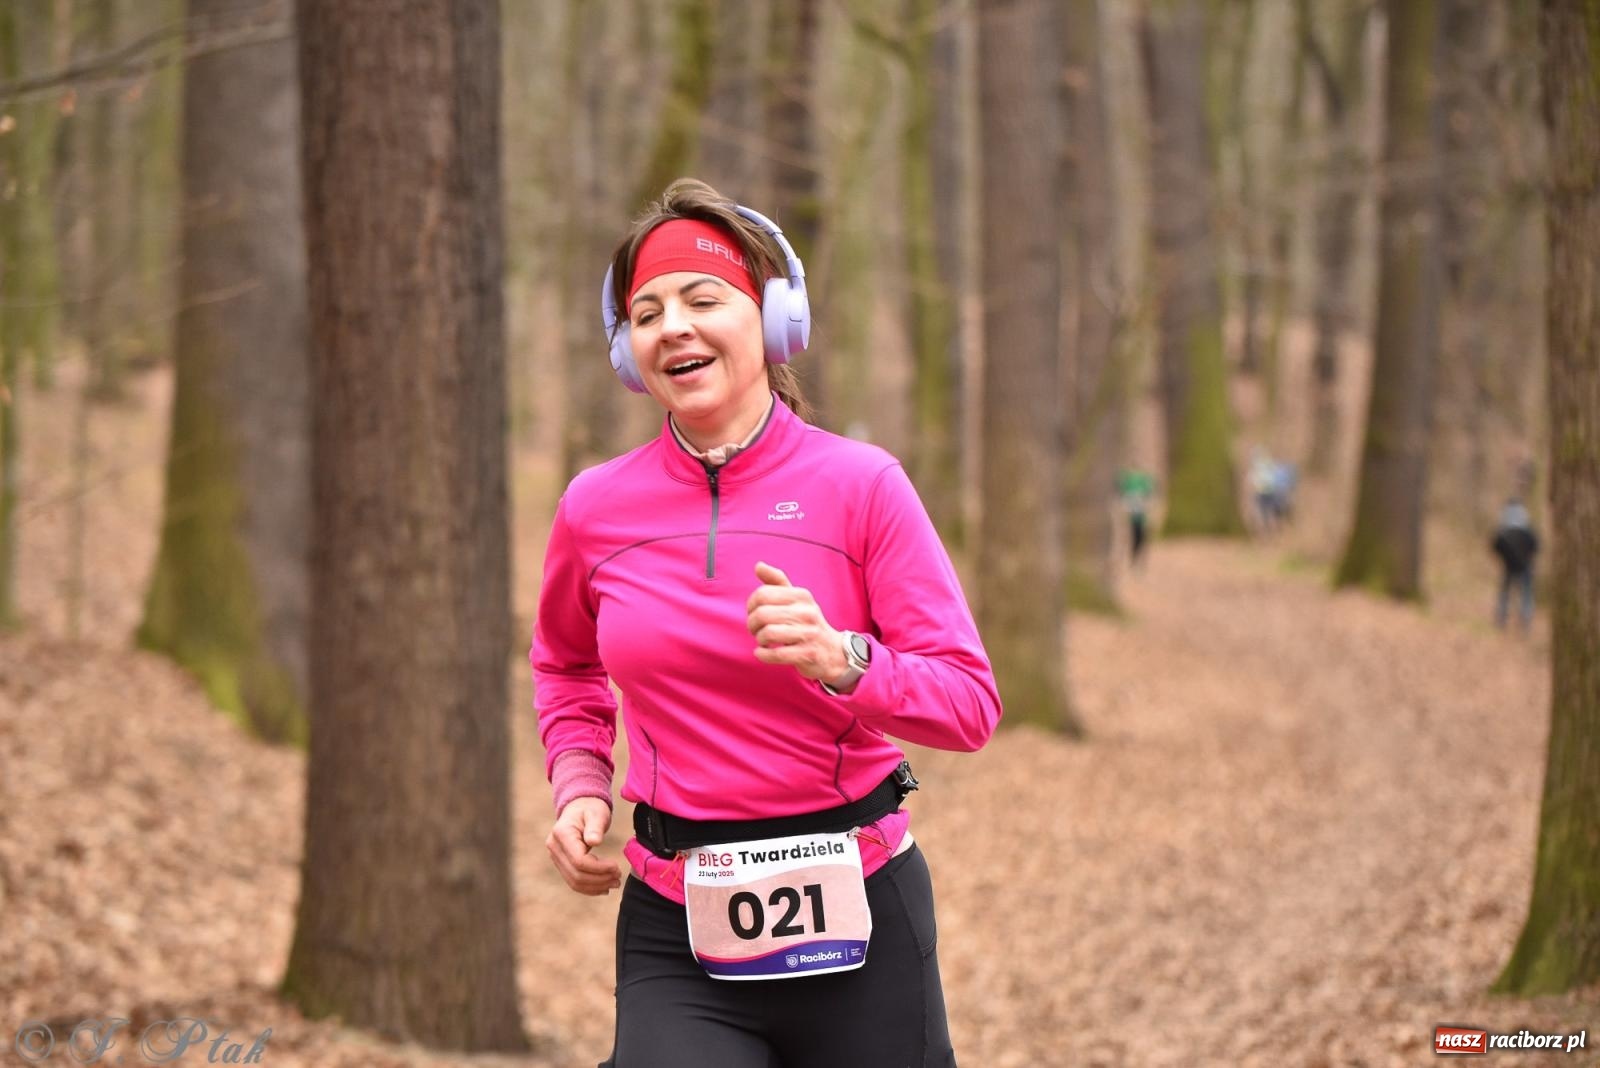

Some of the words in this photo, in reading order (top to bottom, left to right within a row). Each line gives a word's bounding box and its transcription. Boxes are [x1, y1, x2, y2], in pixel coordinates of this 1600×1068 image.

[698, 852, 733, 867] BIEG
[738, 841, 845, 865] Twardziela
[706, 871, 717, 879] luty
[727, 883, 826, 940] 021
[799, 951, 842, 963] Racibórz
